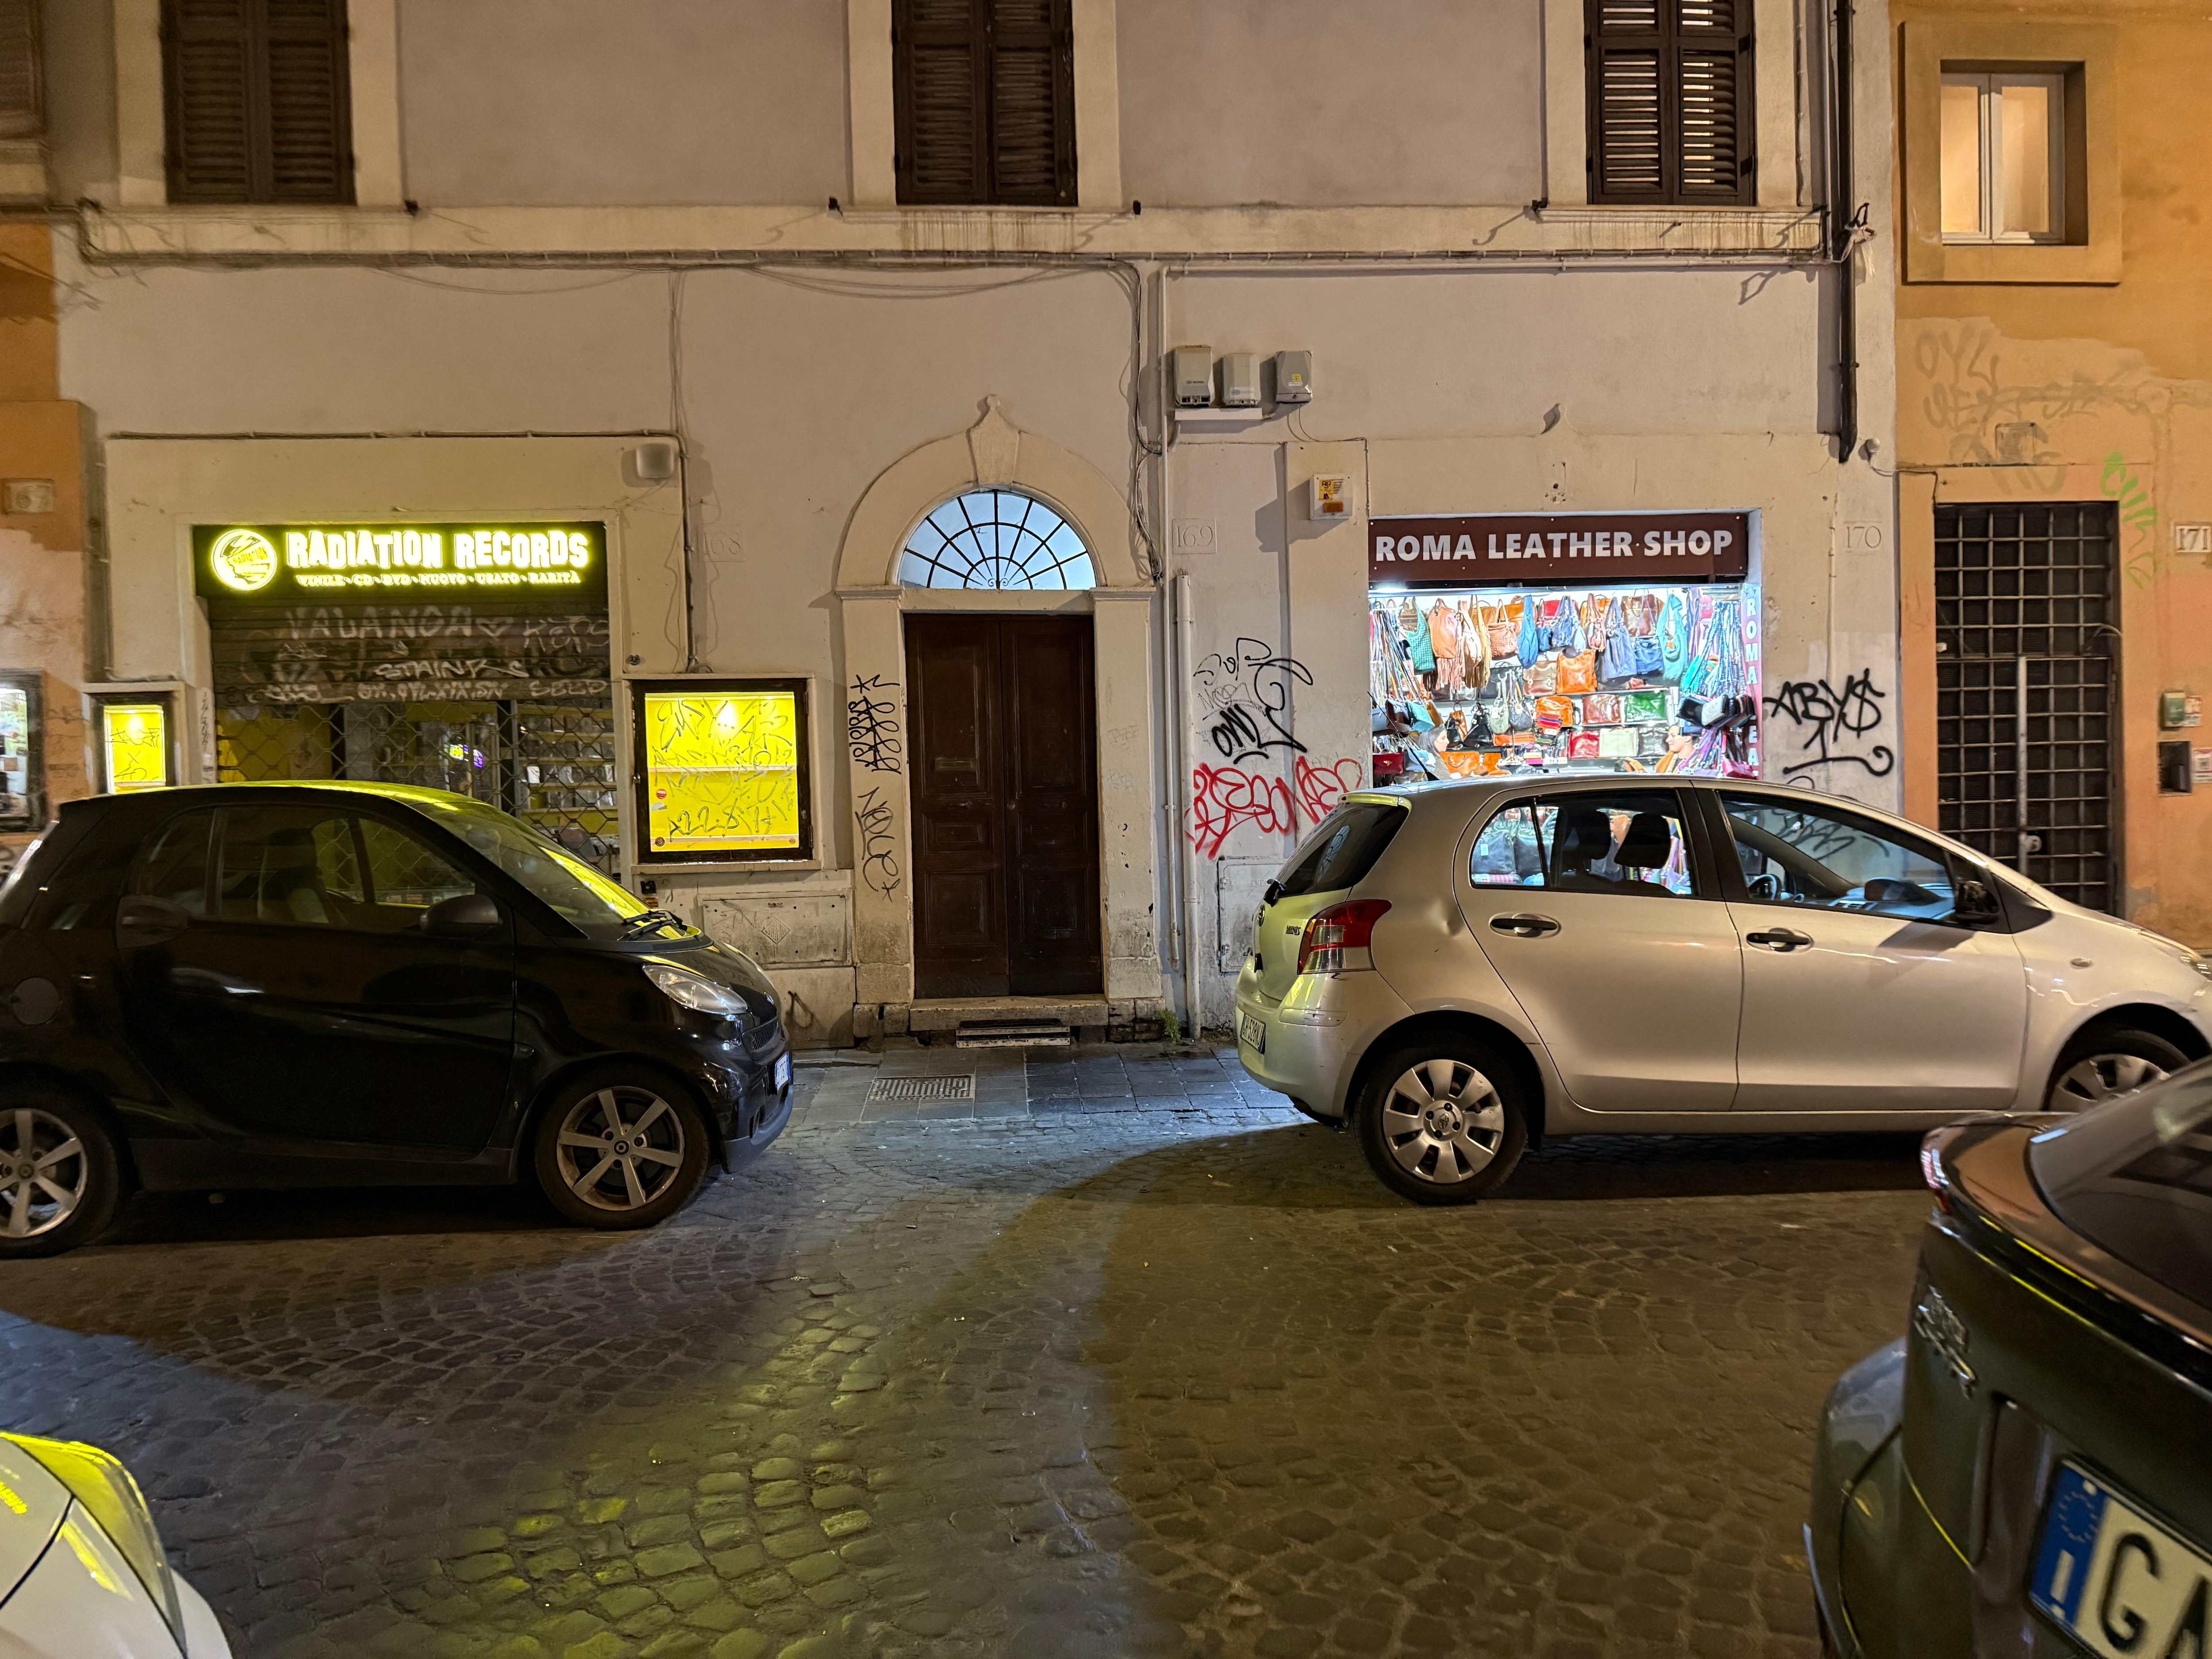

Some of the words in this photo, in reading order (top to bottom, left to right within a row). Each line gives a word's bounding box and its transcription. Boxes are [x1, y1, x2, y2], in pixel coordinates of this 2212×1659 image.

[1175, 525, 1213, 548] 169
[1376, 534, 1476, 561] ROMA
[1488, 531, 1633, 559] LEATHER
[1644, 530, 1732, 557] SHOP
[1846, 525, 1882, 549] 170
[2176, 526, 2209, 550] 171
[286, 530, 443, 569] RADIATION
[454, 530, 588, 568] RECORDS
[296, 575, 346, 587] VINILE
[352, 574, 374, 586] CD
[380, 574, 411, 586] DVD
[418, 573, 467, 585] NUOVO
[475, 572, 520, 584] USATO
[1745, 598, 1758, 685] ROMA
